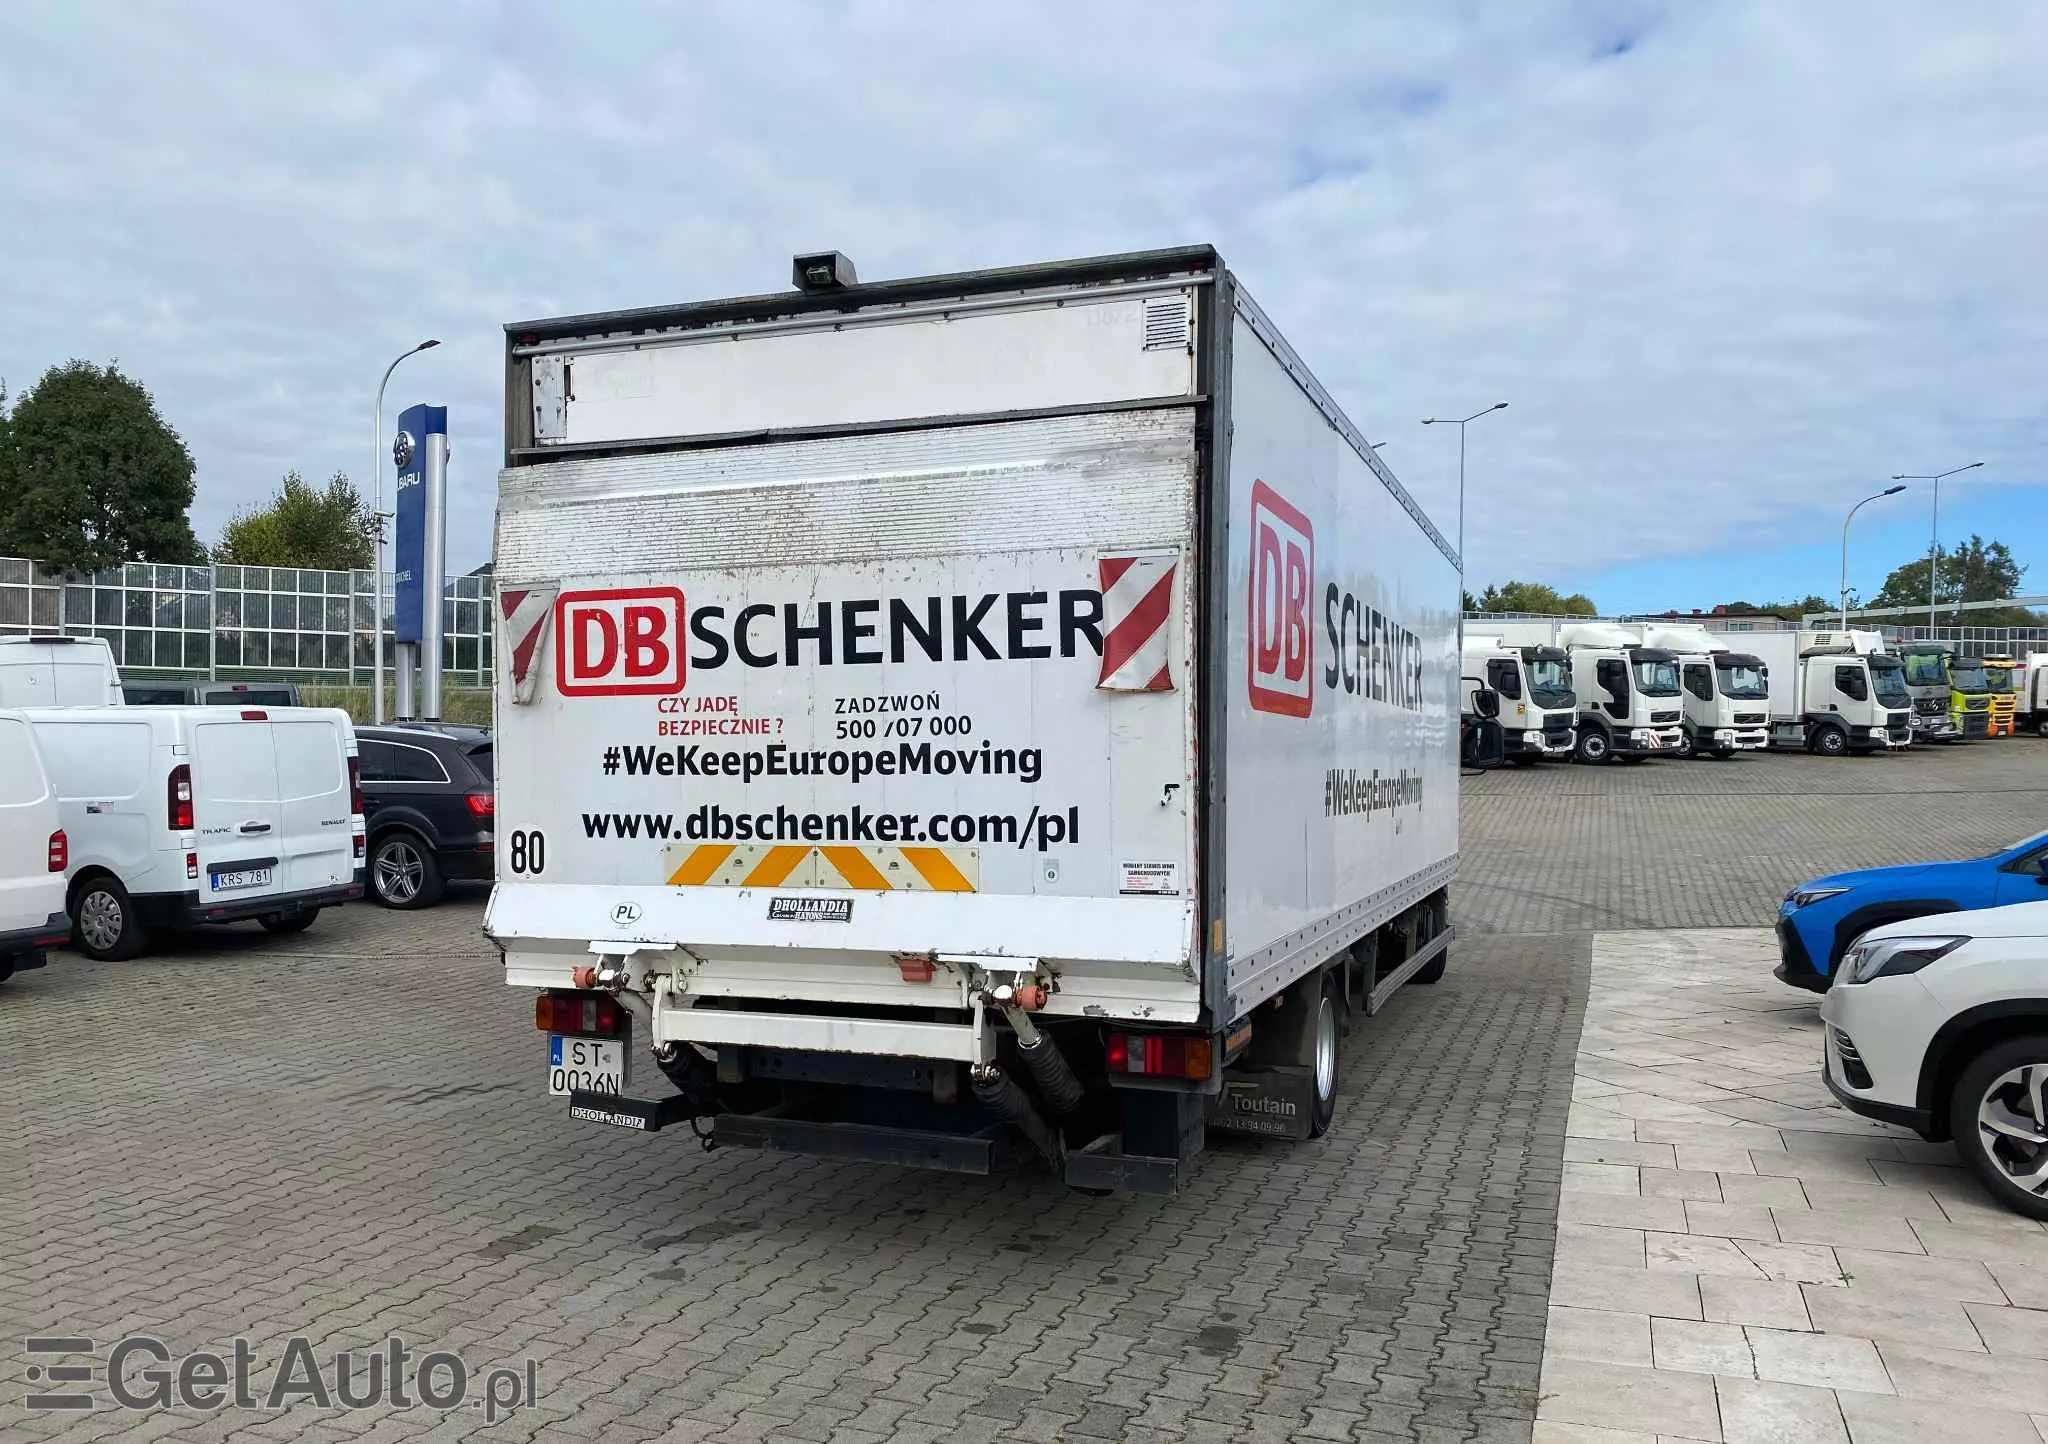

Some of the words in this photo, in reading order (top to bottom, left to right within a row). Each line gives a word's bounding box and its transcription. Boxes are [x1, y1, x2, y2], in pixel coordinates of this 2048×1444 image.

[1257, 521, 1307, 682] DB
[1325, 582, 1424, 712] SCHENKER
[571, 605, 671, 681] DB
[691, 588, 1103, 670] SCHENKER
[658, 697, 689, 714] CZY
[695, 696, 738, 716] JADĘ
[834, 690, 940, 714] ZADZWOŃ
[658, 718, 771, 737] BEZPIECZNIE
[836, 719, 876, 739] 500
[929, 715, 972, 736] 000
[603, 740, 1042, 784] #WeKeepEuropeMoving
[1325, 768, 1423, 823] #WeKeepEuropeMoving
[582, 804, 1079, 852] www.dbschenker.com/pl
[511, 830, 545, 875] 80
[221, 872, 243, 887] KRS
[616, 905, 637, 919] PL
[773, 899, 848, 913] DHOLLANDIA
[572, 1041, 603, 1067] ST
[1231, 1093, 1296, 1116] Toutain
